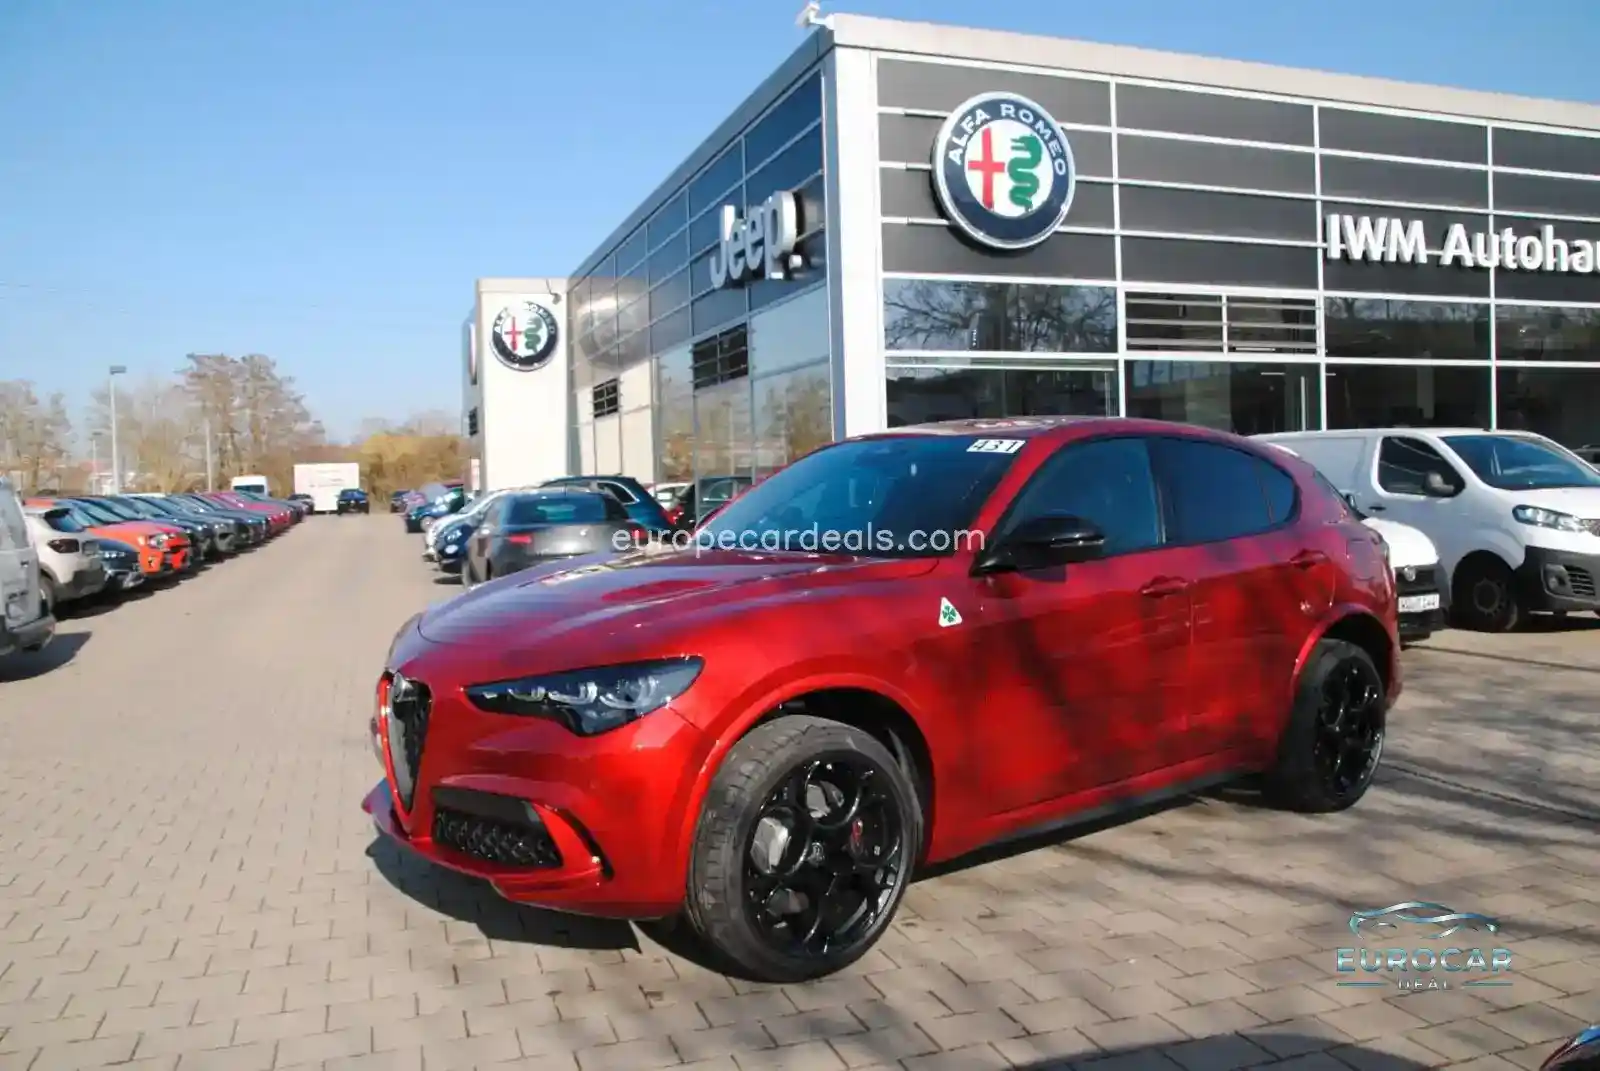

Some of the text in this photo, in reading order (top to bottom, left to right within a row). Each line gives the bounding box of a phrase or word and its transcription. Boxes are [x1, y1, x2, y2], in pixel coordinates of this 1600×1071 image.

[948, 103, 1067, 176] ALFA ROMEO
[709, 190, 798, 289] Jeep
[1326, 213, 1428, 265] IWM
